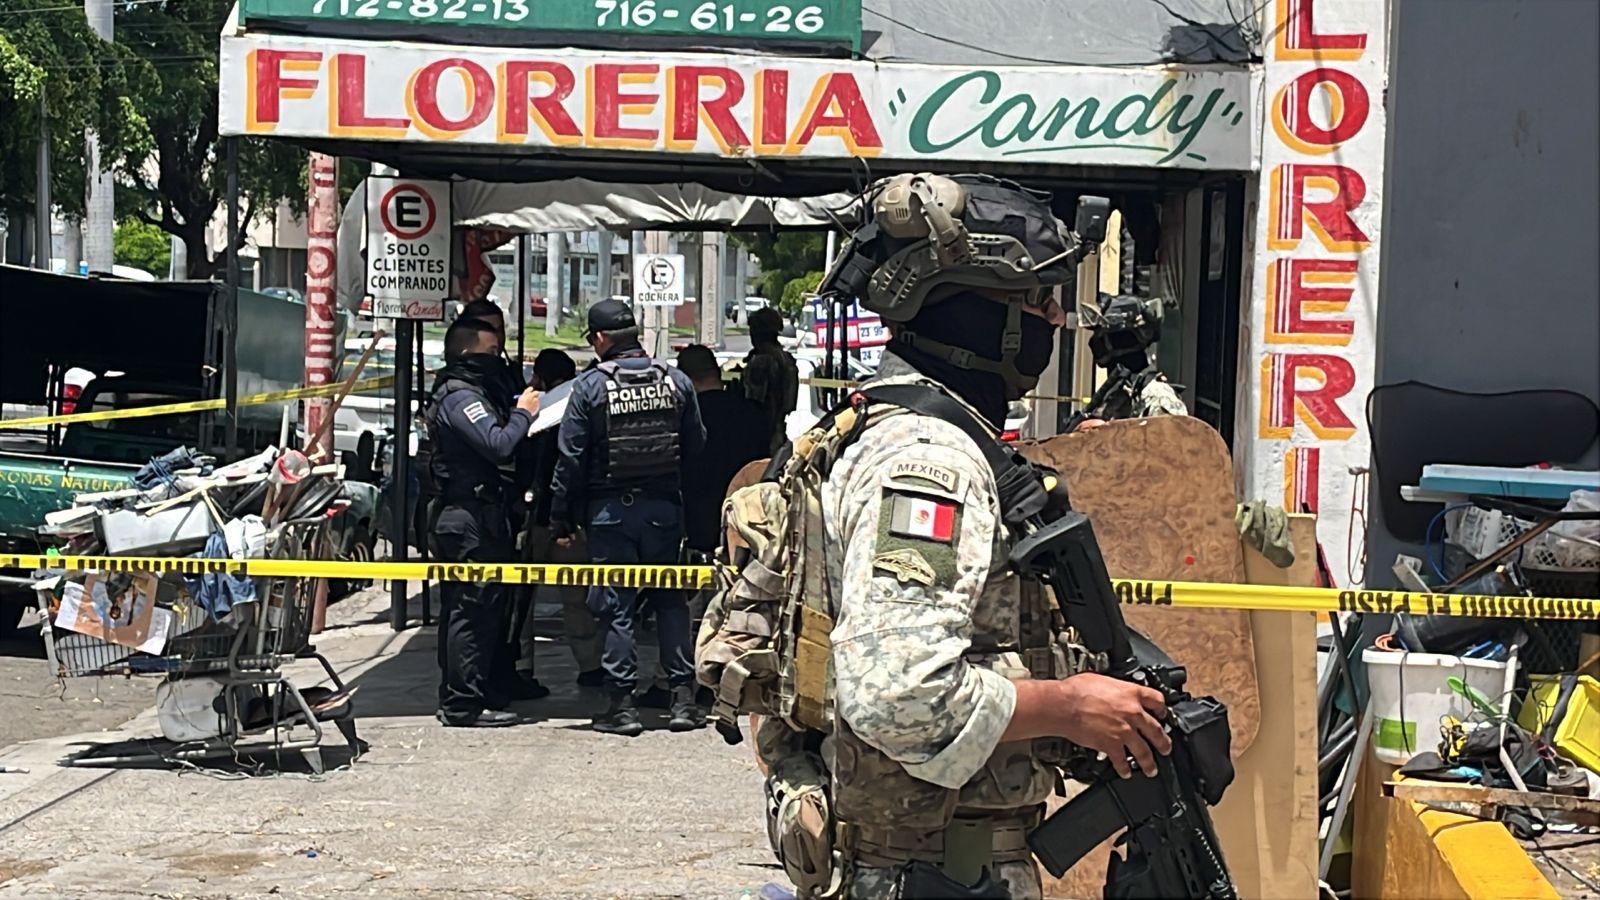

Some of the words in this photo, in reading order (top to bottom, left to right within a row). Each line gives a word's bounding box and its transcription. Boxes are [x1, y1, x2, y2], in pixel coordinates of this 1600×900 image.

[595, 0, 824, 33] 716-61-26
[245, 47, 883, 156] FLORERIA
[395, 196, 422, 228] E
[387, 243, 430, 256] SOLO
[373, 258, 445, 273] CLIENTES
[370, 275, 446, 291] COMPRANDO
[638, 292, 680, 303] COCHERA
[610, 397, 673, 415] MUNICIPAL
[896, 462, 950, 483] MEXICO
